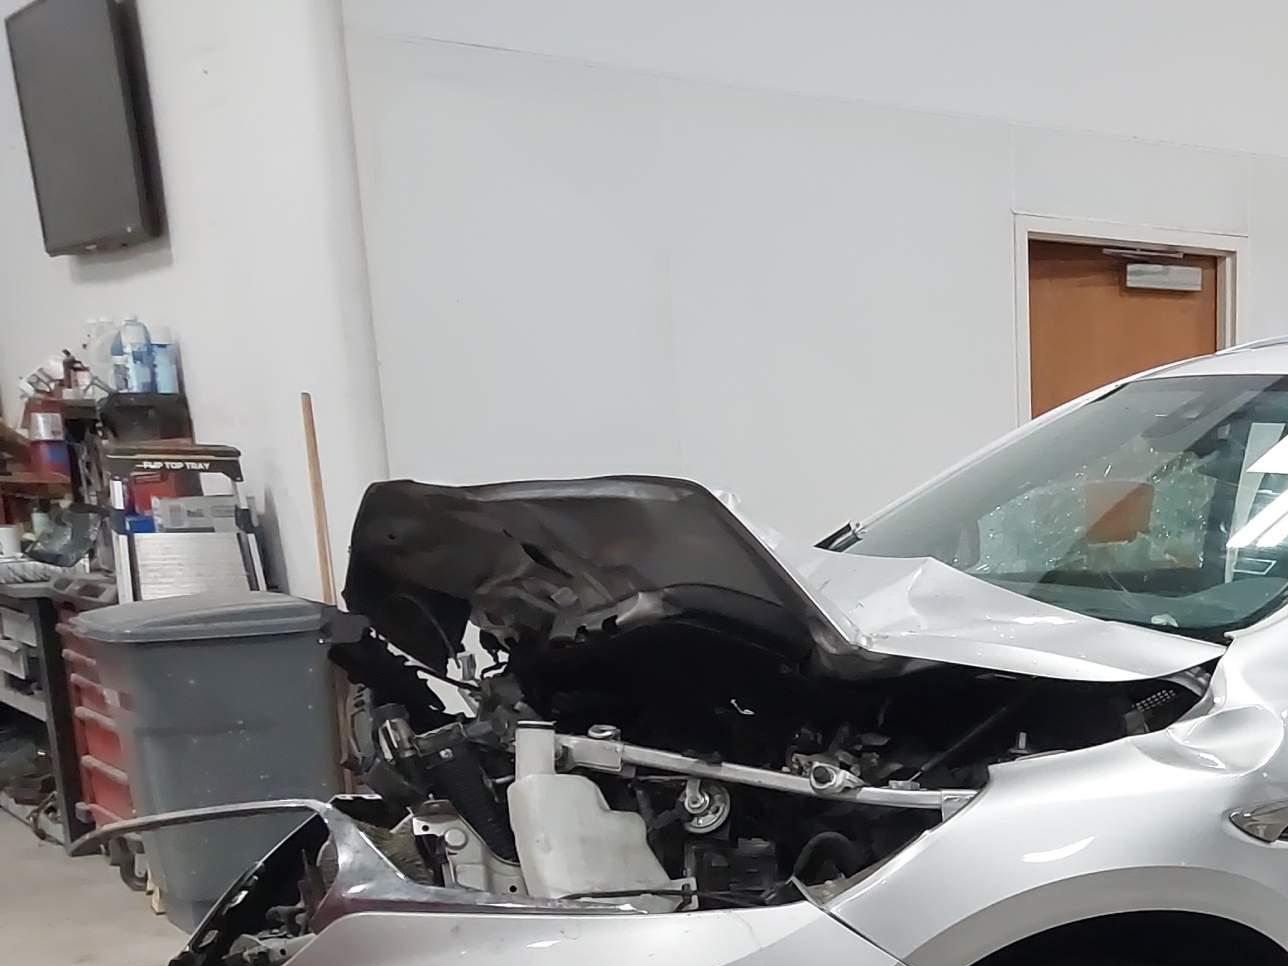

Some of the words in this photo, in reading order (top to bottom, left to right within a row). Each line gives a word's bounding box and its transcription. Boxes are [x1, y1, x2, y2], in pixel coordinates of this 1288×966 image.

[143, 461, 163, 470] FLIP
[164, 461, 184, 470] TOP
[185, 462, 211, 471] TRAY
